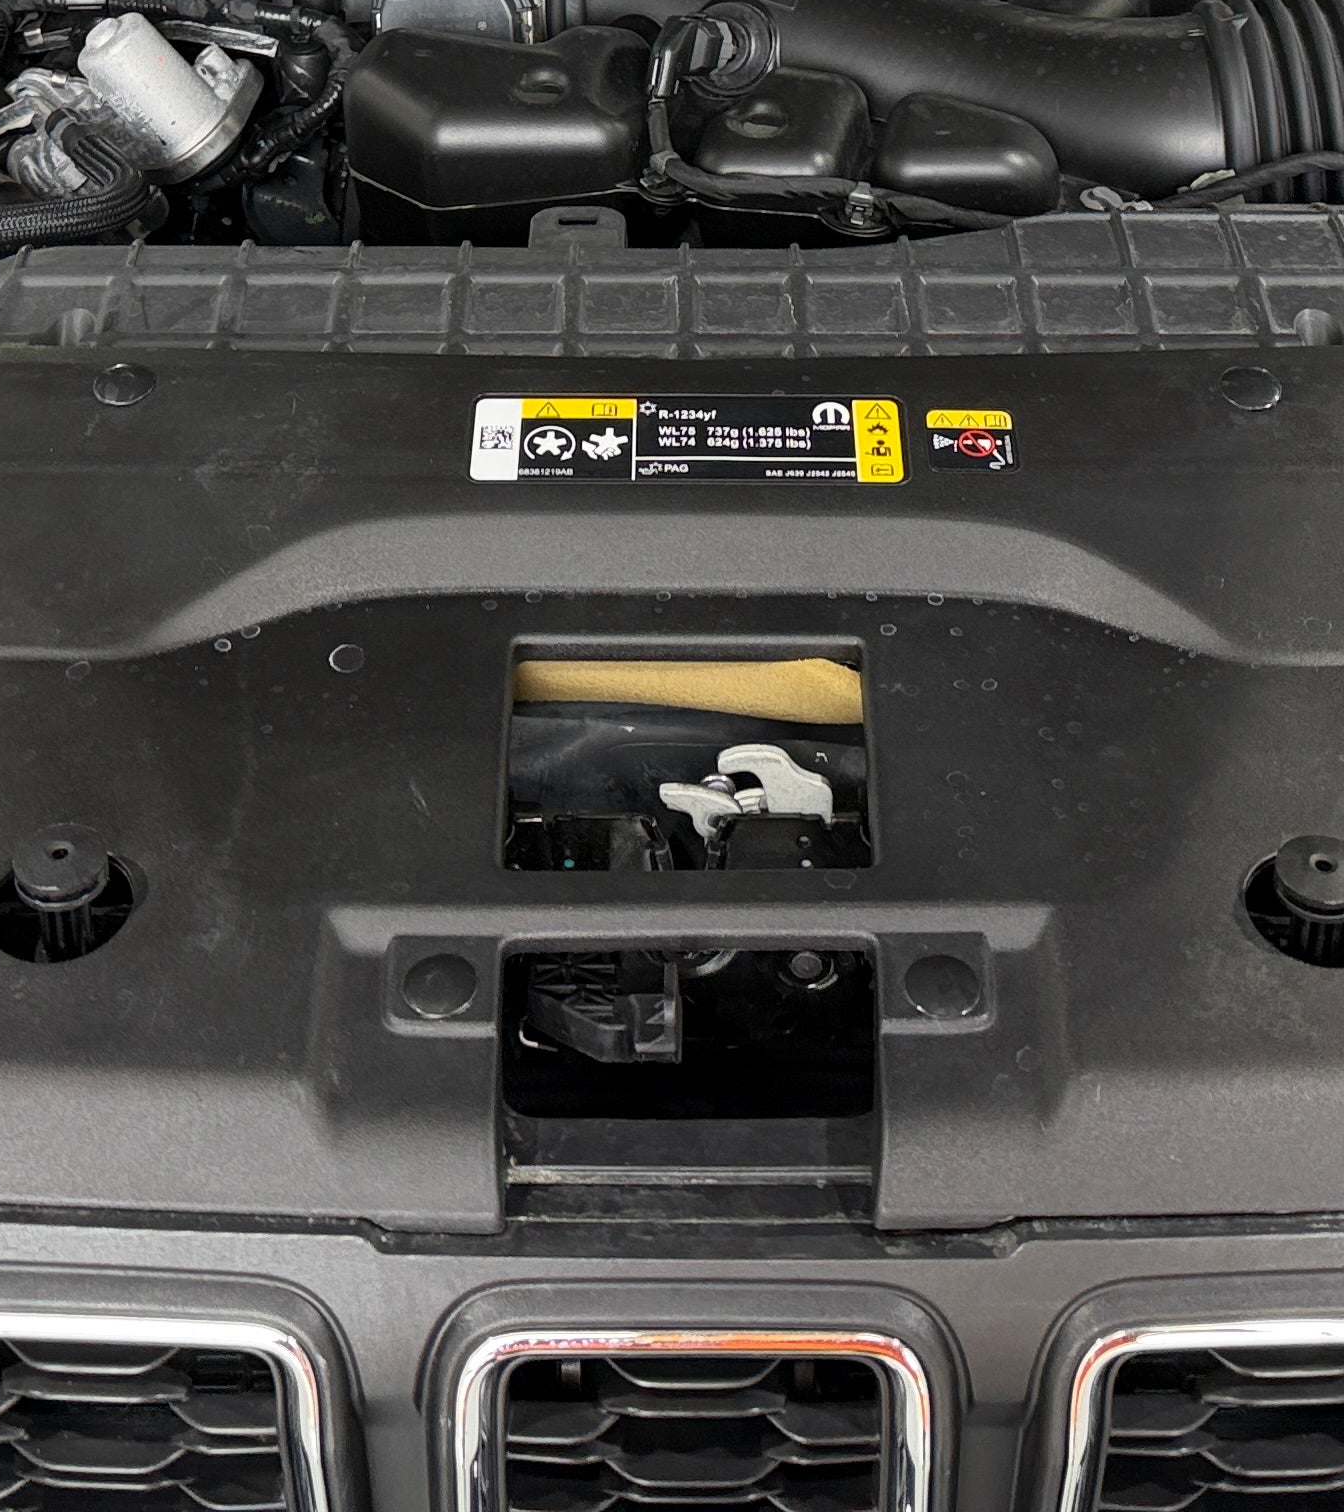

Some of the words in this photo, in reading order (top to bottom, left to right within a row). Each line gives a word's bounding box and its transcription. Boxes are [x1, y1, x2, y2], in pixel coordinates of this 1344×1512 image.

[658, 409, 717, 422] R-1234yf
[706, 426, 739, 438] 737g
[785, 426, 811, 438] lbs)
[658, 436, 697, 447] WL74
[706, 437, 739, 449] 624g
[785, 437, 812, 450] lbs)
